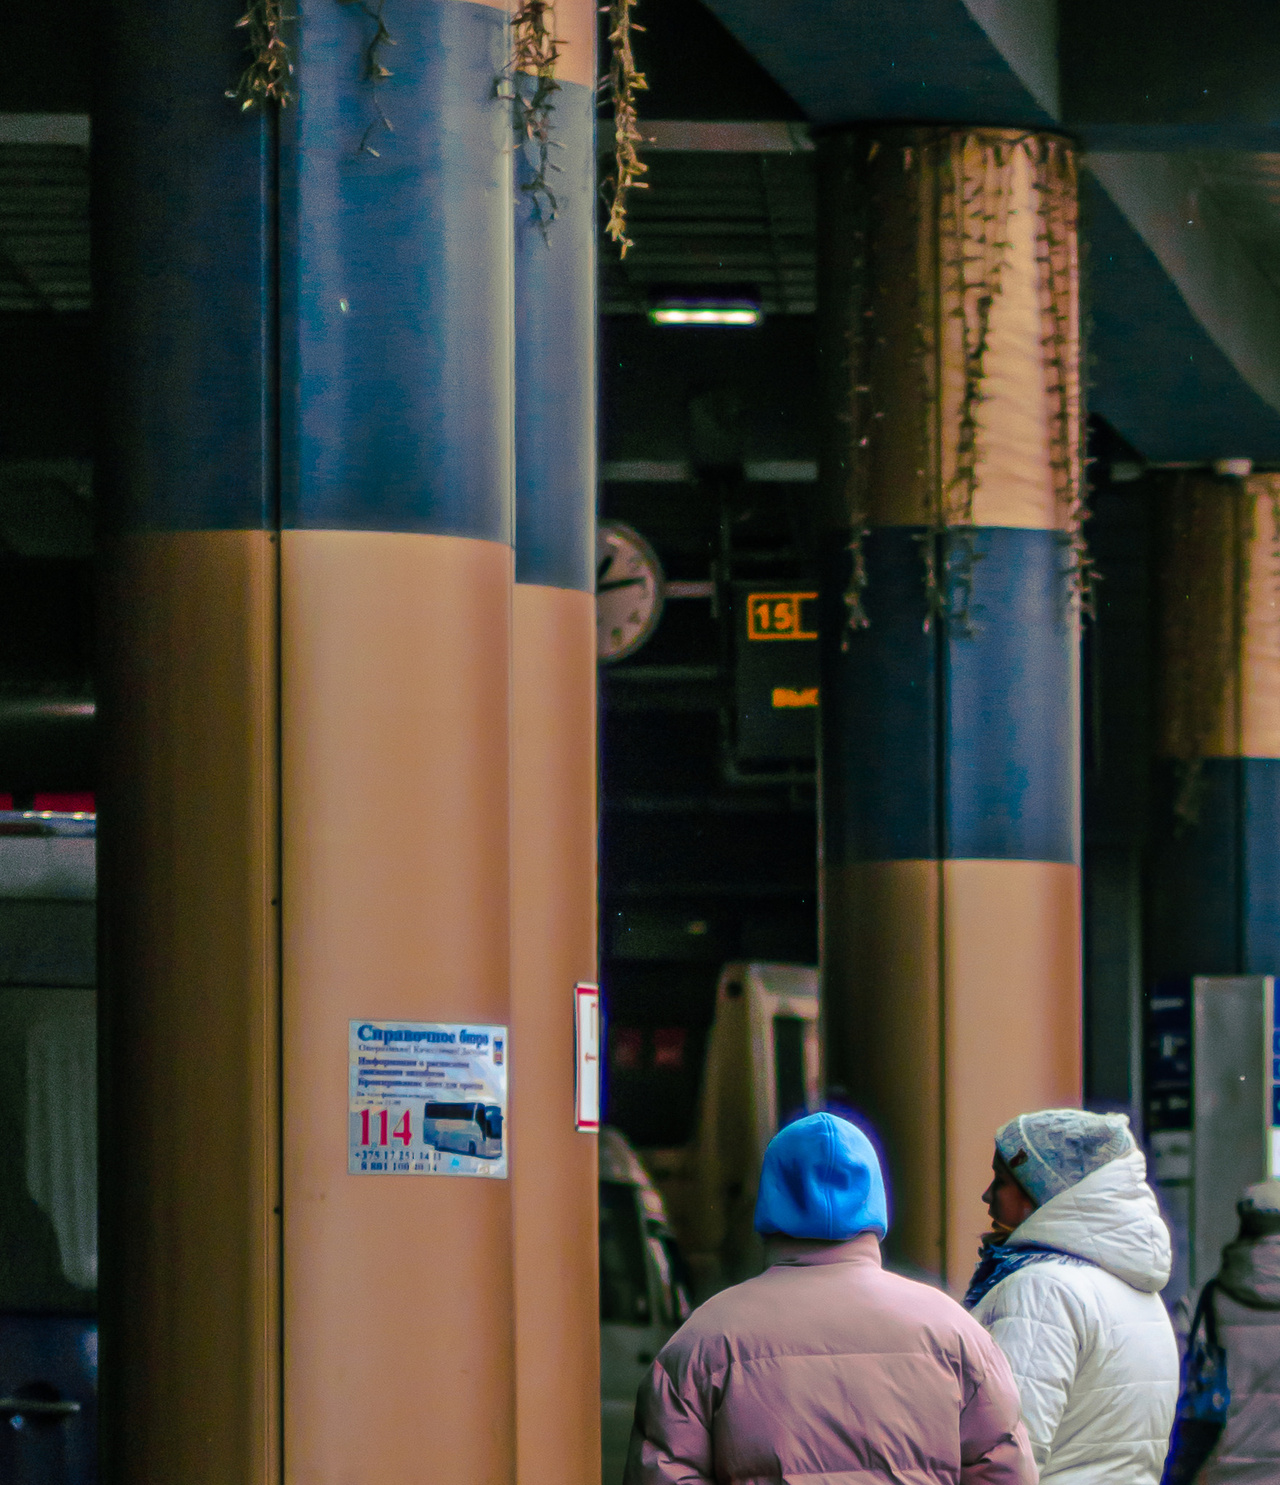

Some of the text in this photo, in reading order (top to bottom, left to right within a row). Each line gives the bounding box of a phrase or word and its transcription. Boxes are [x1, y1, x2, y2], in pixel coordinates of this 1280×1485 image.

[755, 603, 793, 630] 15
[357, 1024, 489, 1049] Справочное бюро
[359, 1109, 413, 1146] 114
